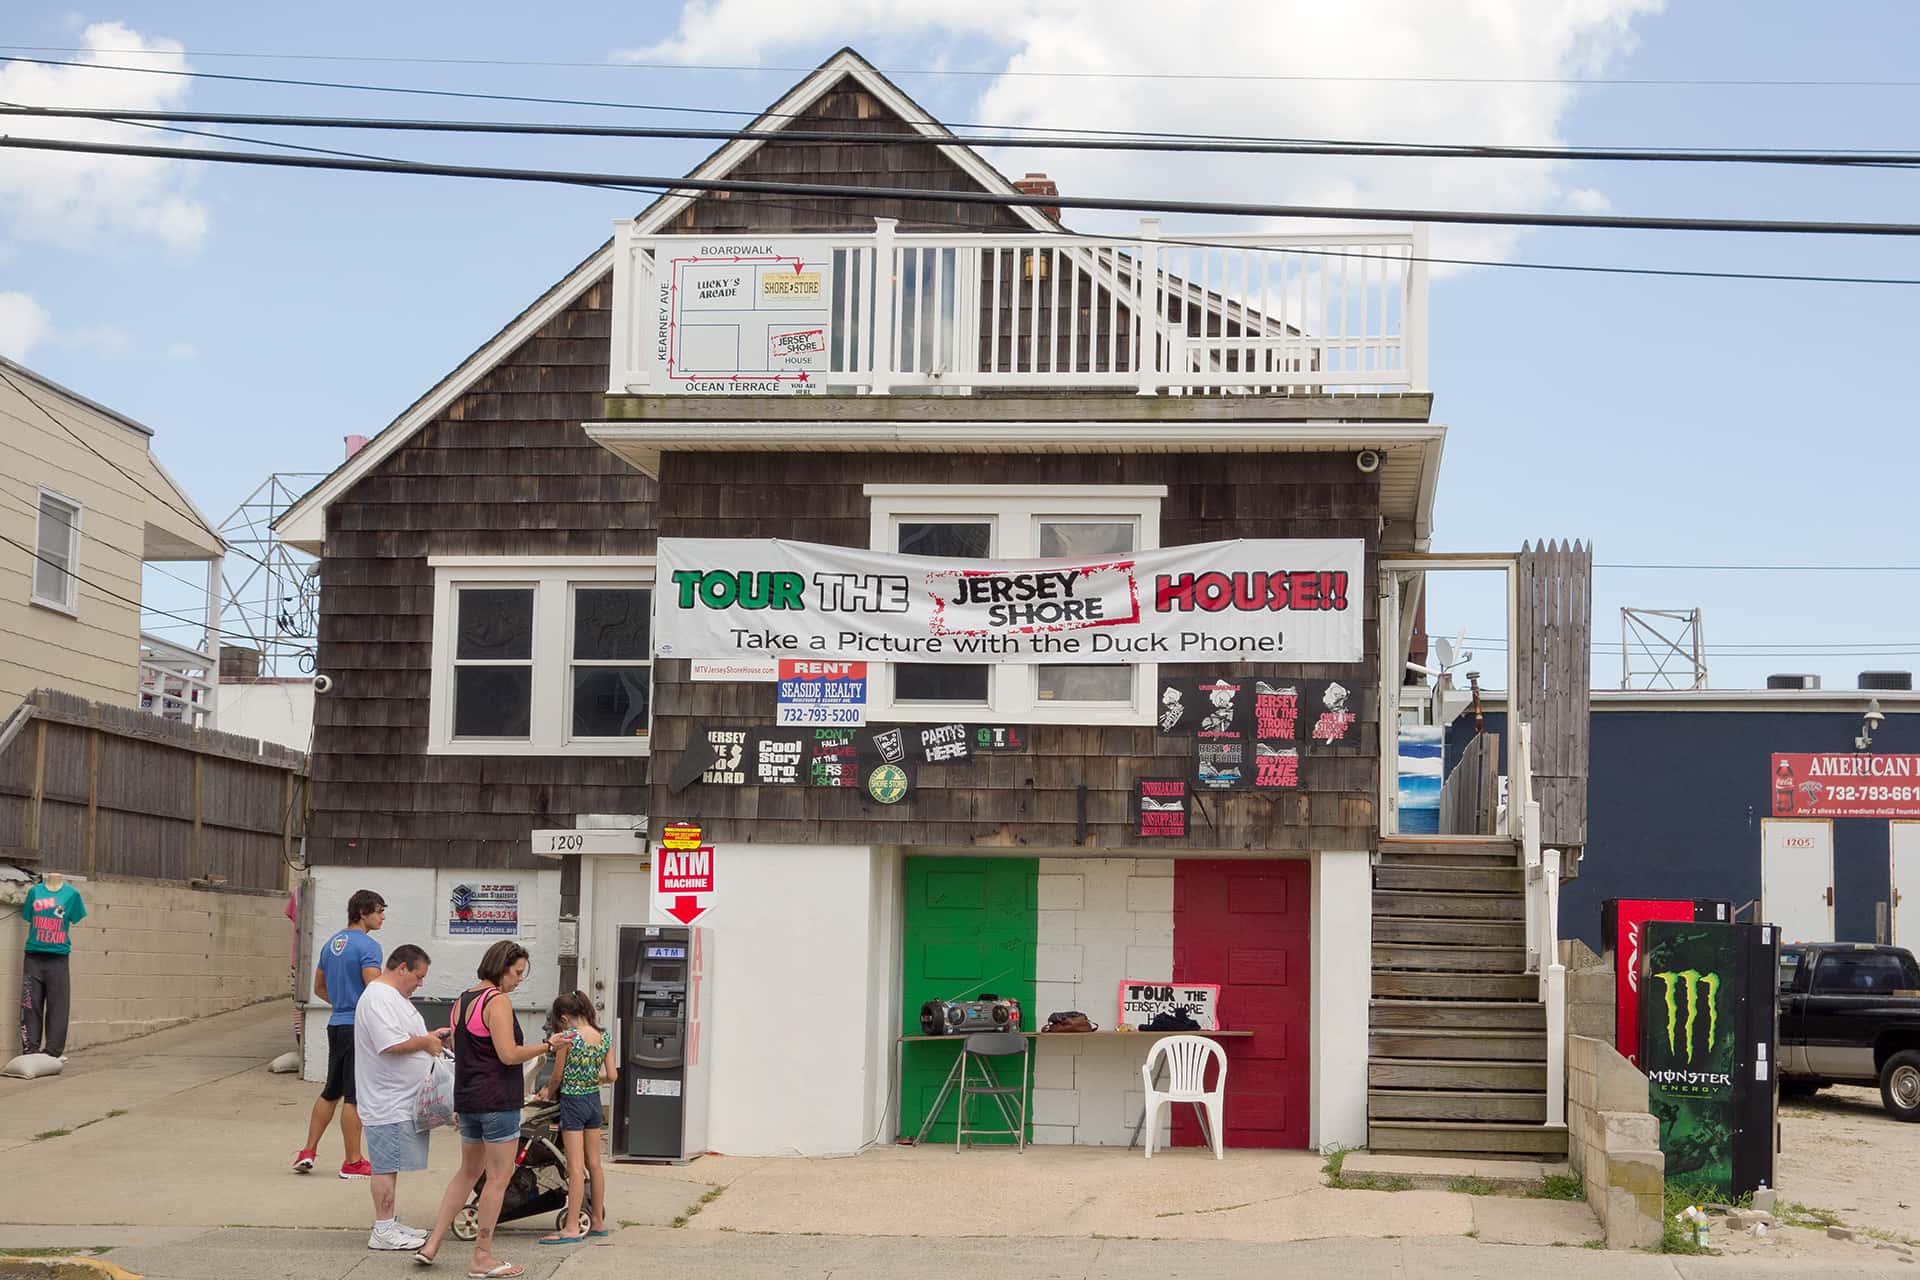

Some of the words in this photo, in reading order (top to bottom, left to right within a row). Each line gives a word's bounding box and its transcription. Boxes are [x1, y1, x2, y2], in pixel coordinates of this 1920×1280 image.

[701, 246, 774, 255] BOARDWALK
[660, 279, 670, 305] AVE.
[698, 288, 737, 300] ARCADE
[764, 281, 790, 295] SHORE
[792, 281, 819, 294] STORE
[658, 308, 668, 361] KEARNEY
[778, 334, 811, 346] JERSEY
[787, 342, 817, 353] SHORE
[685, 382, 727, 392] OCEAN
[729, 382, 780, 391] TERRACE
[672, 569, 806, 611] TOUR
[813, 571, 910, 613] THE
[1155, 570, 1348, 613] HOUSE!!
[952, 571, 1081, 605] JERSEY
[988, 597, 1104, 628] SHORE
[730, 628, 798, 649] Take
[809, 634, 826, 650] a
[838, 631, 942, 653] Picture
[952, 632, 1025, 653] with
[1030, 632, 1081, 653] the
[1092, 632, 1169, 652] Duck
[1180, 631, 1284, 652] Phone!
[794, 662, 852, 674] RENT
[782, 683, 821, 698] SEASIDE
[825, 683, 862, 698] REALTY
[1255, 695, 1297, 708] JERSEY
[783, 708, 859, 722] 732-793-5200
[1255, 708, 1279, 718] ONLY
[1280, 708, 1298, 718] THE
[1257, 718, 1294, 729] STRONG
[815, 729, 856, 739] DON'T
[1257, 728, 1295, 739] SURVIVE
[759, 741, 802, 753] Cool
[925, 742, 967, 762] HERE
[759, 752, 801, 765] Story
[758, 764, 798, 776] Bro.
[812, 763, 857, 776] JERSEY
[1257, 765, 1297, 776] THE
[1808, 757, 1911, 777] AMERICAN
[702, 772, 744, 784] HARD
[816, 777, 856, 786] SHORE
[1255, 776, 1297, 786] SHORE
[551, 835, 584, 851] 1209
[1786, 839, 1810, 847] 1205
[663, 851, 709, 876] ATM
[664, 878, 708, 888] MACHINE
[655, 948, 679, 956] ATM
[688, 927, 703, 1066] ATM
[1128, 986, 1175, 1001] TOUR
[1184, 991, 1207, 1001] THE
[1124, 1001, 1161, 1013] JERSEY
[1648, 1069, 1731, 1085] MONSTER
[1661, 1084, 1720, 1093] ENERGY
